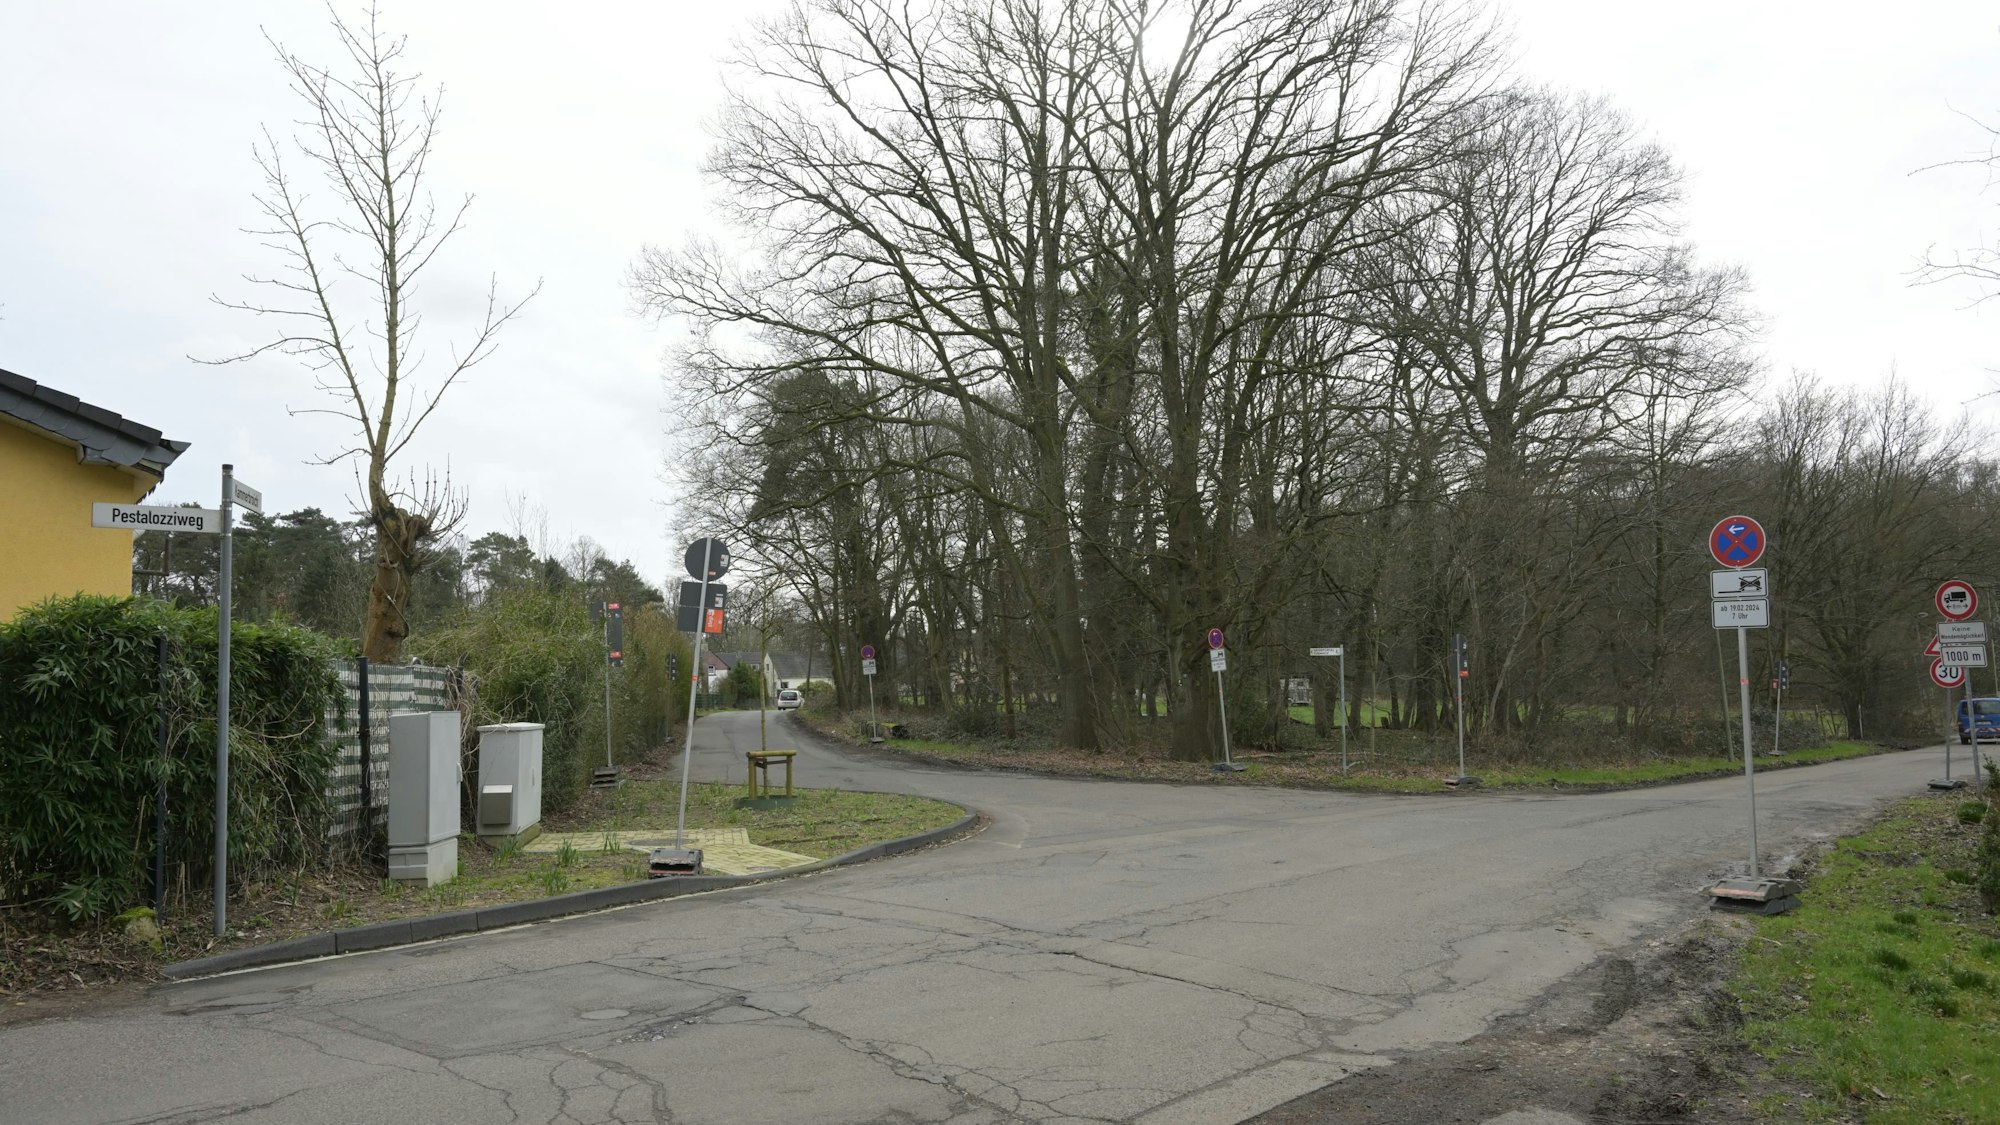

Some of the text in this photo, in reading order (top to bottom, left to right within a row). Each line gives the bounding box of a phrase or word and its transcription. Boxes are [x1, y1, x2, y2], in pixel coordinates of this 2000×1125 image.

[112, 507, 204, 530] Pestalozziweg
[1732, 612, 1748, 620] 7 Uhr
[1945, 651, 1981, 661] 1000 m
[1938, 664, 1959, 679] 30
